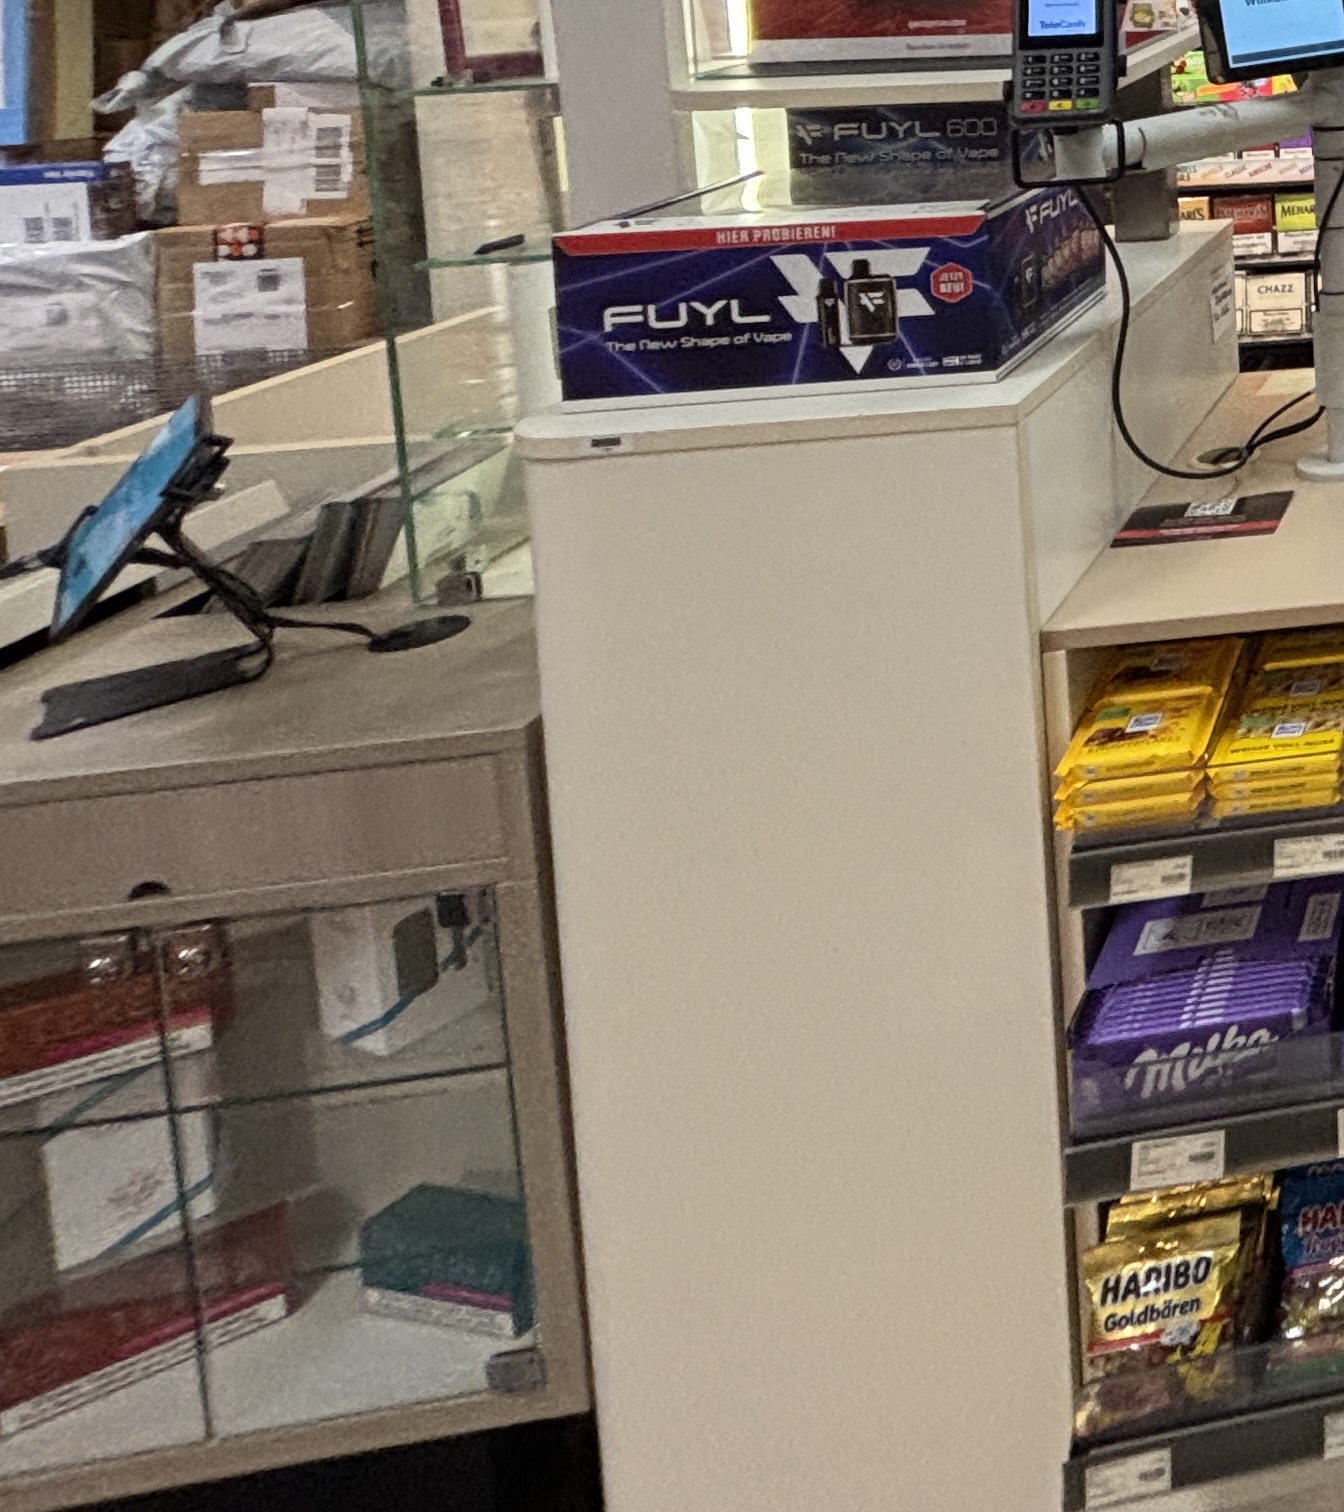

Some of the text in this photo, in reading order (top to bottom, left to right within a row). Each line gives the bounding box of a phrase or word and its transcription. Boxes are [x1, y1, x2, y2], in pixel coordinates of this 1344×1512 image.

[1039, 20, 1086, 30] TeleCash
[833, 117, 998, 142] FUYL 600
[799, 151, 832, 165] The
[833, 150, 877, 165] New
[879, 148, 931, 167] Shape
[957, 146, 999, 166] Vape
[715, 225, 836, 244] HIER PROBIEREN!
[939, 271, 964, 282] JETZT
[1256, 283, 1295, 295] CHAZZ
[602, 296, 771, 333] FUYL
[604, 329, 793, 353] The New Shape of Vape
[1124, 1023, 1280, 1100] Milka
[1100, 1255, 1213, 1307] HARIBO
[1103, 1296, 1201, 1332] Goldbären
